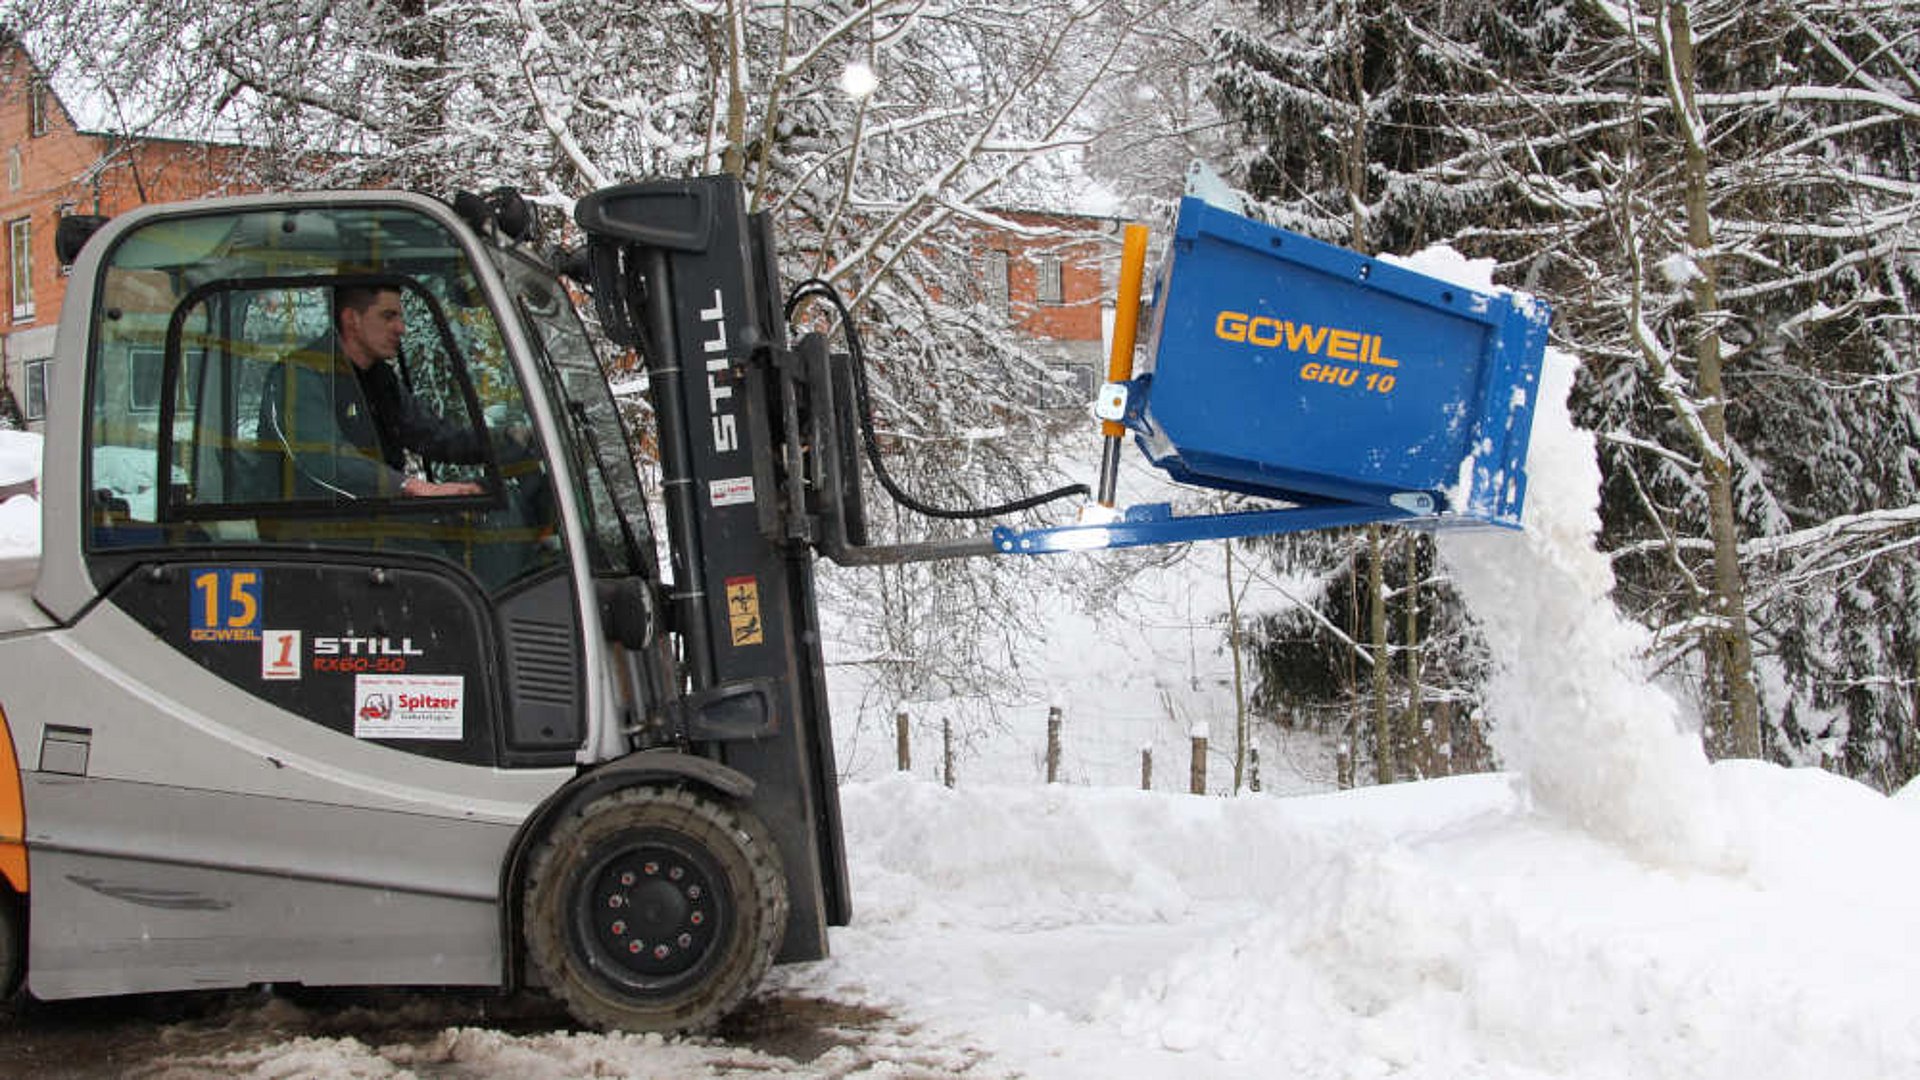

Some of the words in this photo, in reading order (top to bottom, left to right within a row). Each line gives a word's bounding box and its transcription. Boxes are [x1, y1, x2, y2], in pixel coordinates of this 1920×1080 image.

[700, 289, 738, 452] STILL
[1300, 363, 1359, 386] GHU
[1366, 373, 1396, 393] 10
[196, 572, 257, 627] 15
[272, 634, 294, 667] 1
[314, 638, 423, 655] STILL
[399, 694, 459, 712] Spitzer
